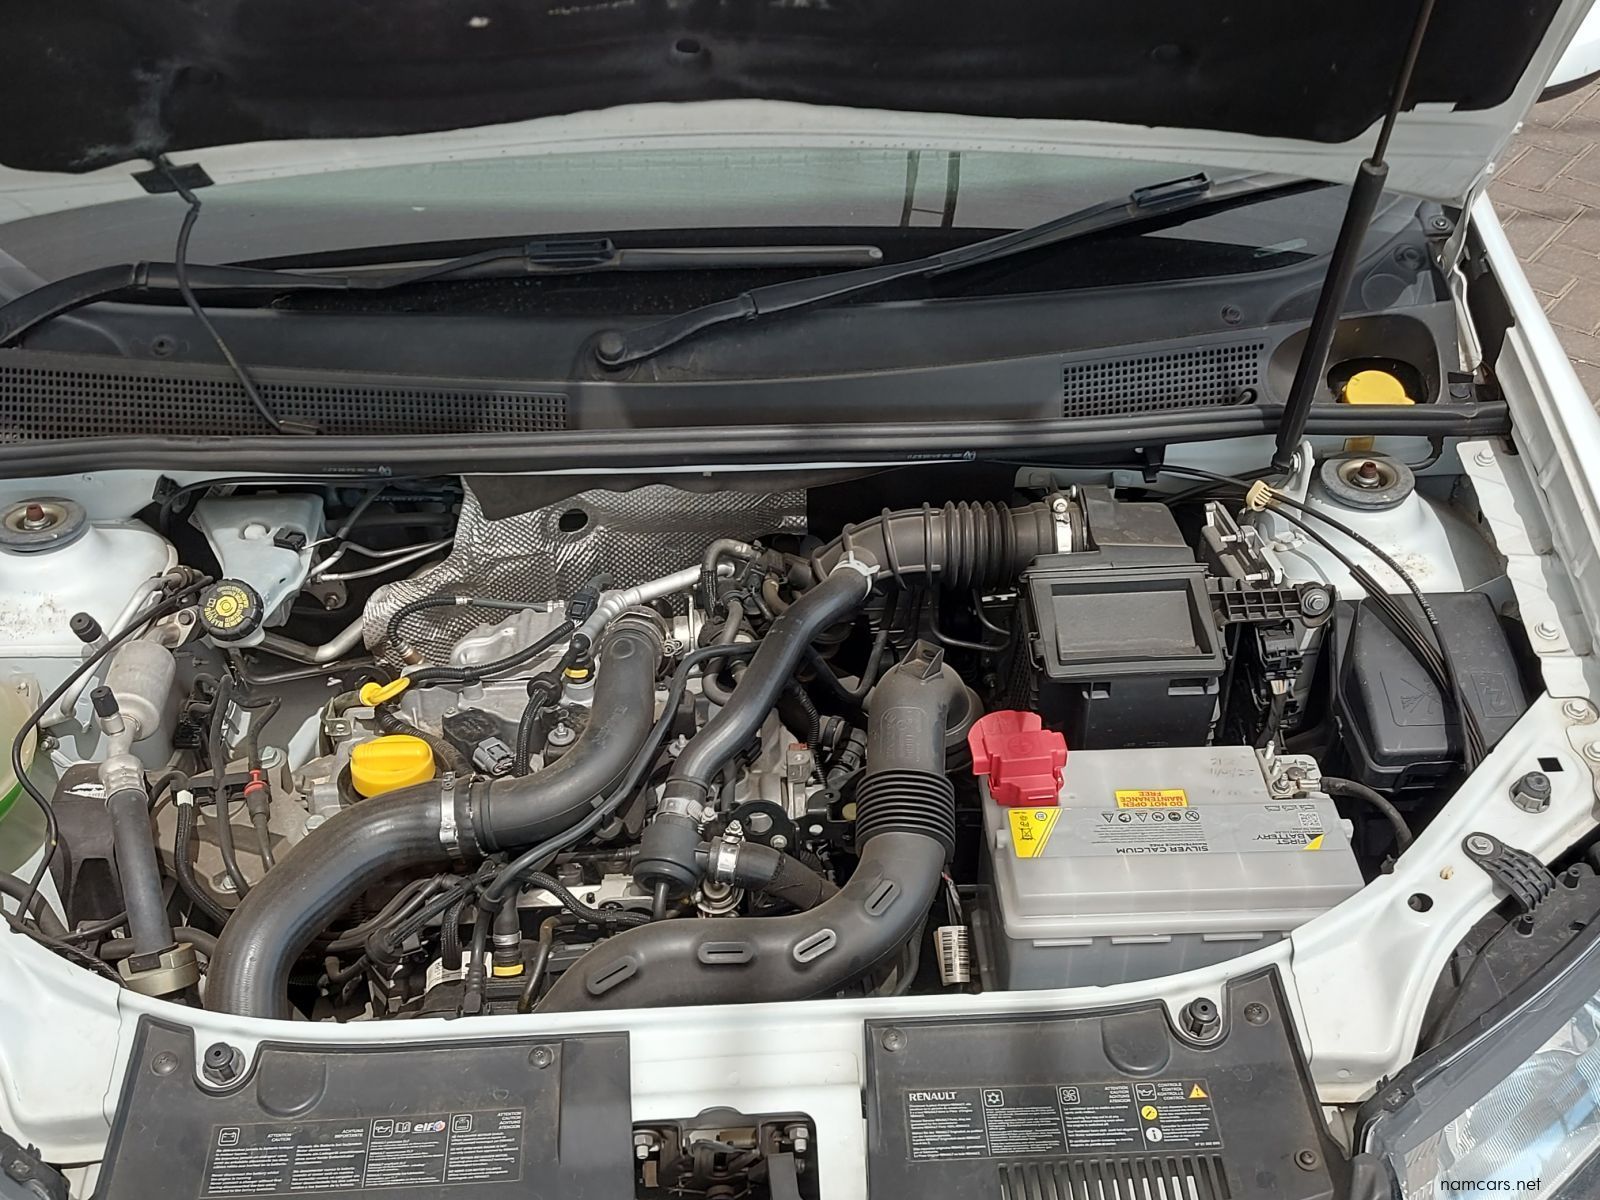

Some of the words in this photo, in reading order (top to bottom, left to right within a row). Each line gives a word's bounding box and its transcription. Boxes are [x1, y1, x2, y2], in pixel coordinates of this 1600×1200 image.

[1115, 846, 1167, 854] CALCIUM
[1169, 845, 1209, 853] SILVER
[908, 1091, 957, 1102] RENAULT
[413, 1122, 435, 1132] elf
